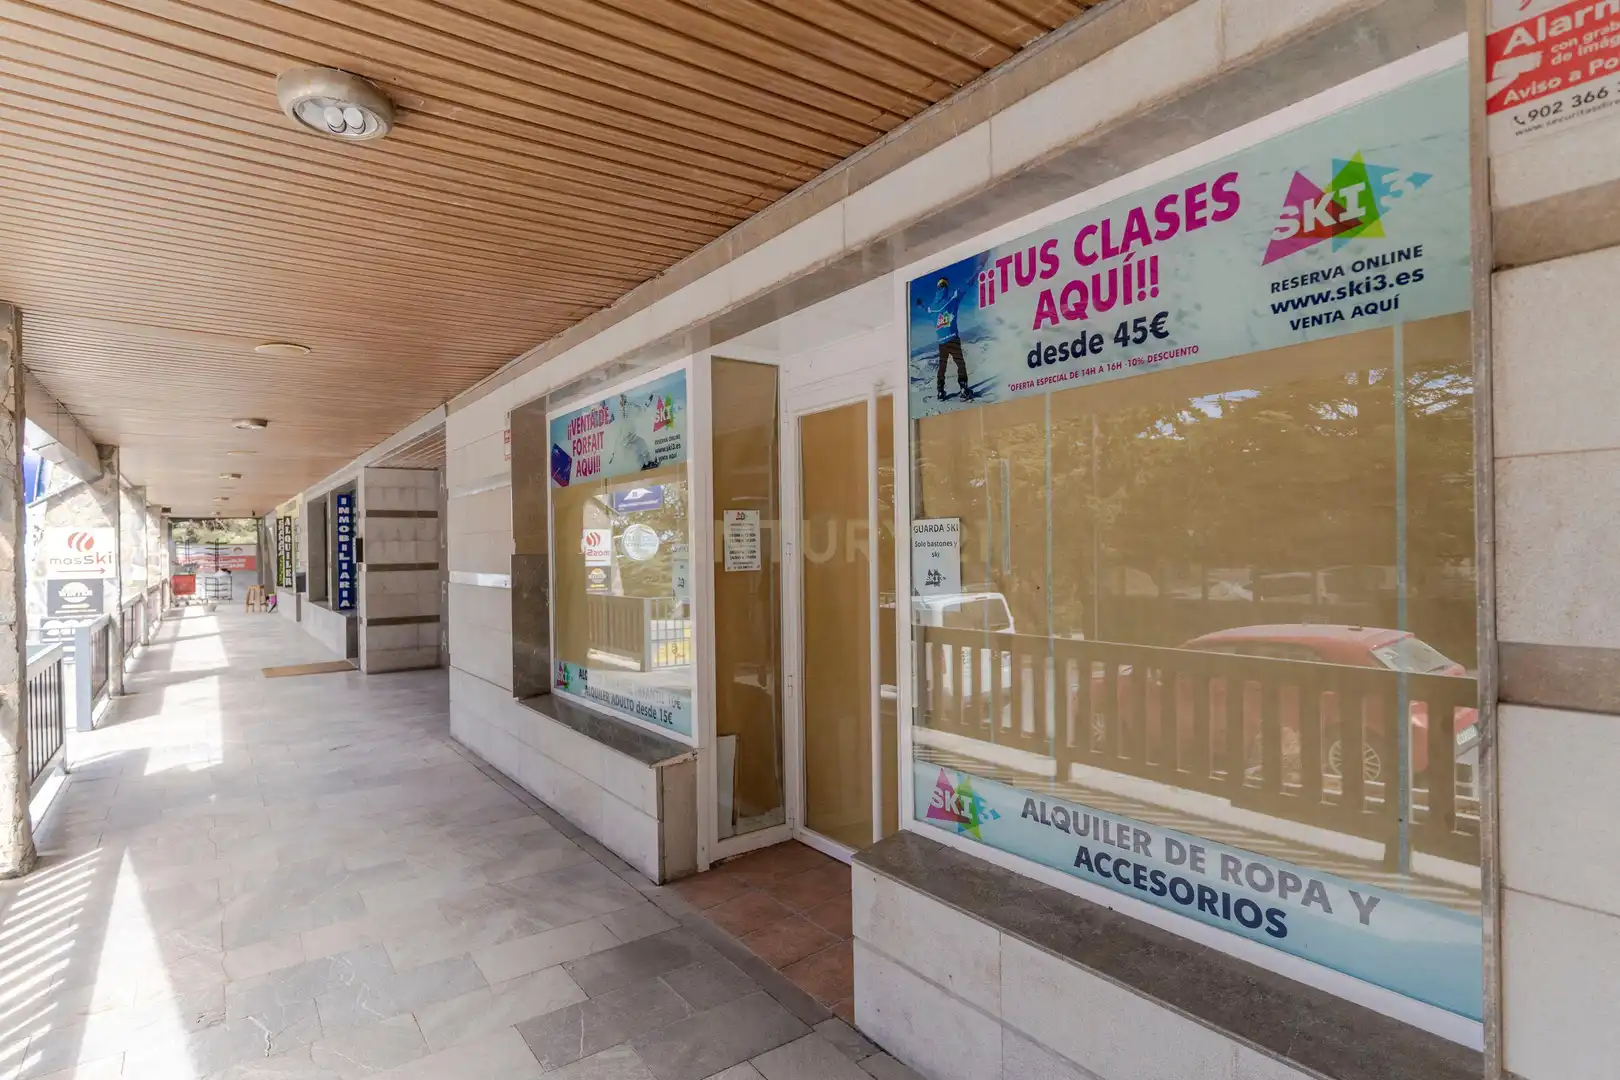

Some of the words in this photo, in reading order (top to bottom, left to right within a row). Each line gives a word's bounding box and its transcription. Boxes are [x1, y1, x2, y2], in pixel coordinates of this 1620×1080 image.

[1551, 37, 1578, 53] con
[1551, 52, 1572, 65] de
[1503, 77, 1562, 106] Aviso
[1568, 70, 1581, 83] a
[1528, 100, 1563, 122] 902
[1572, 86, 1609, 108] 366
[1073, 172, 1241, 266] CLASES
[1271, 265, 1345, 294] RESERVA
[1352, 244, 1423, 273] ONLINE
[1032, 251, 1159, 330] AQUÍ!!
[1270, 268, 1425, 314] www.ski3.es
[1289, 310, 1345, 331] VENTA
[1351, 294, 1400, 318] AQUÍ
[1027, 330, 1104, 369] desde
[1114, 311, 1170, 347] 45€
[1036, 373, 1068, 387] ESPECIAL
[1070, 371, 1080, 379] DE
[1081, 368, 1096, 377] 14H
[1098, 366, 1105, 374] A
[1107, 361, 1123, 372] 16H
[1147, 345, 1200, 364] DESCUENTO
[572, 430, 605, 457] FORFAIT
[913, 523, 945, 534] GUARDA
[946, 523, 959, 532] SKI
[914, 540, 926, 548] Solo
[927, 540, 953, 548] bastones
[954, 541, 958, 549] y
[338, 497, 351, 608] INMOBILIARIA
[611, 693, 635, 711] ADULTO
[636, 700, 657, 720] desde
[659, 708, 673, 725] 15€
[1020, 796, 1152, 858] ALQUILER
[1165, 837, 1206, 874] DE
[1221, 853, 1333, 914] ROPA
[1348, 890, 1381, 926] Y
[1074, 846, 1289, 939] ACCESORIOS
